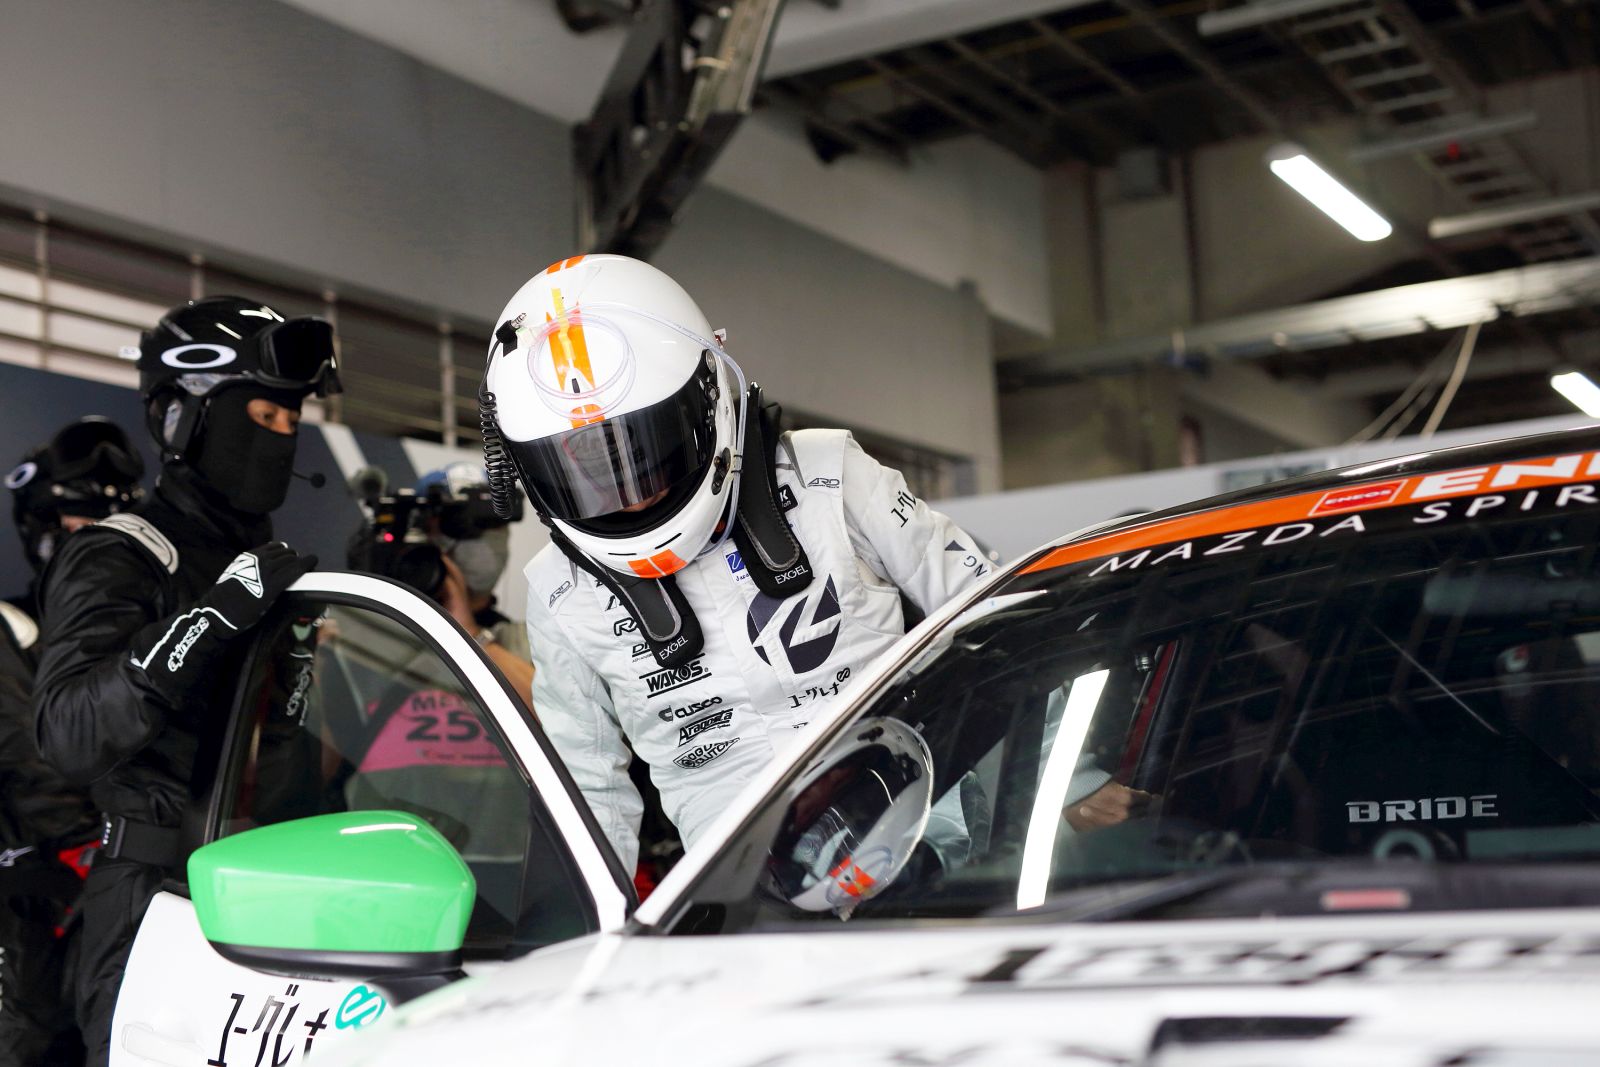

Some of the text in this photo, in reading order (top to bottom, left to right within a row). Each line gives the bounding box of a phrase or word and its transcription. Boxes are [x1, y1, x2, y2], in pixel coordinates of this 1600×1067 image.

[1324, 452, 1600, 505] ENEOS EN
[1088, 484, 1600, 577] MAZDA SPIR
[774, 564, 809, 585] EXGEL
[659, 635, 688, 660] EXGEL
[1345, 794, 1499, 823] BRIDE
